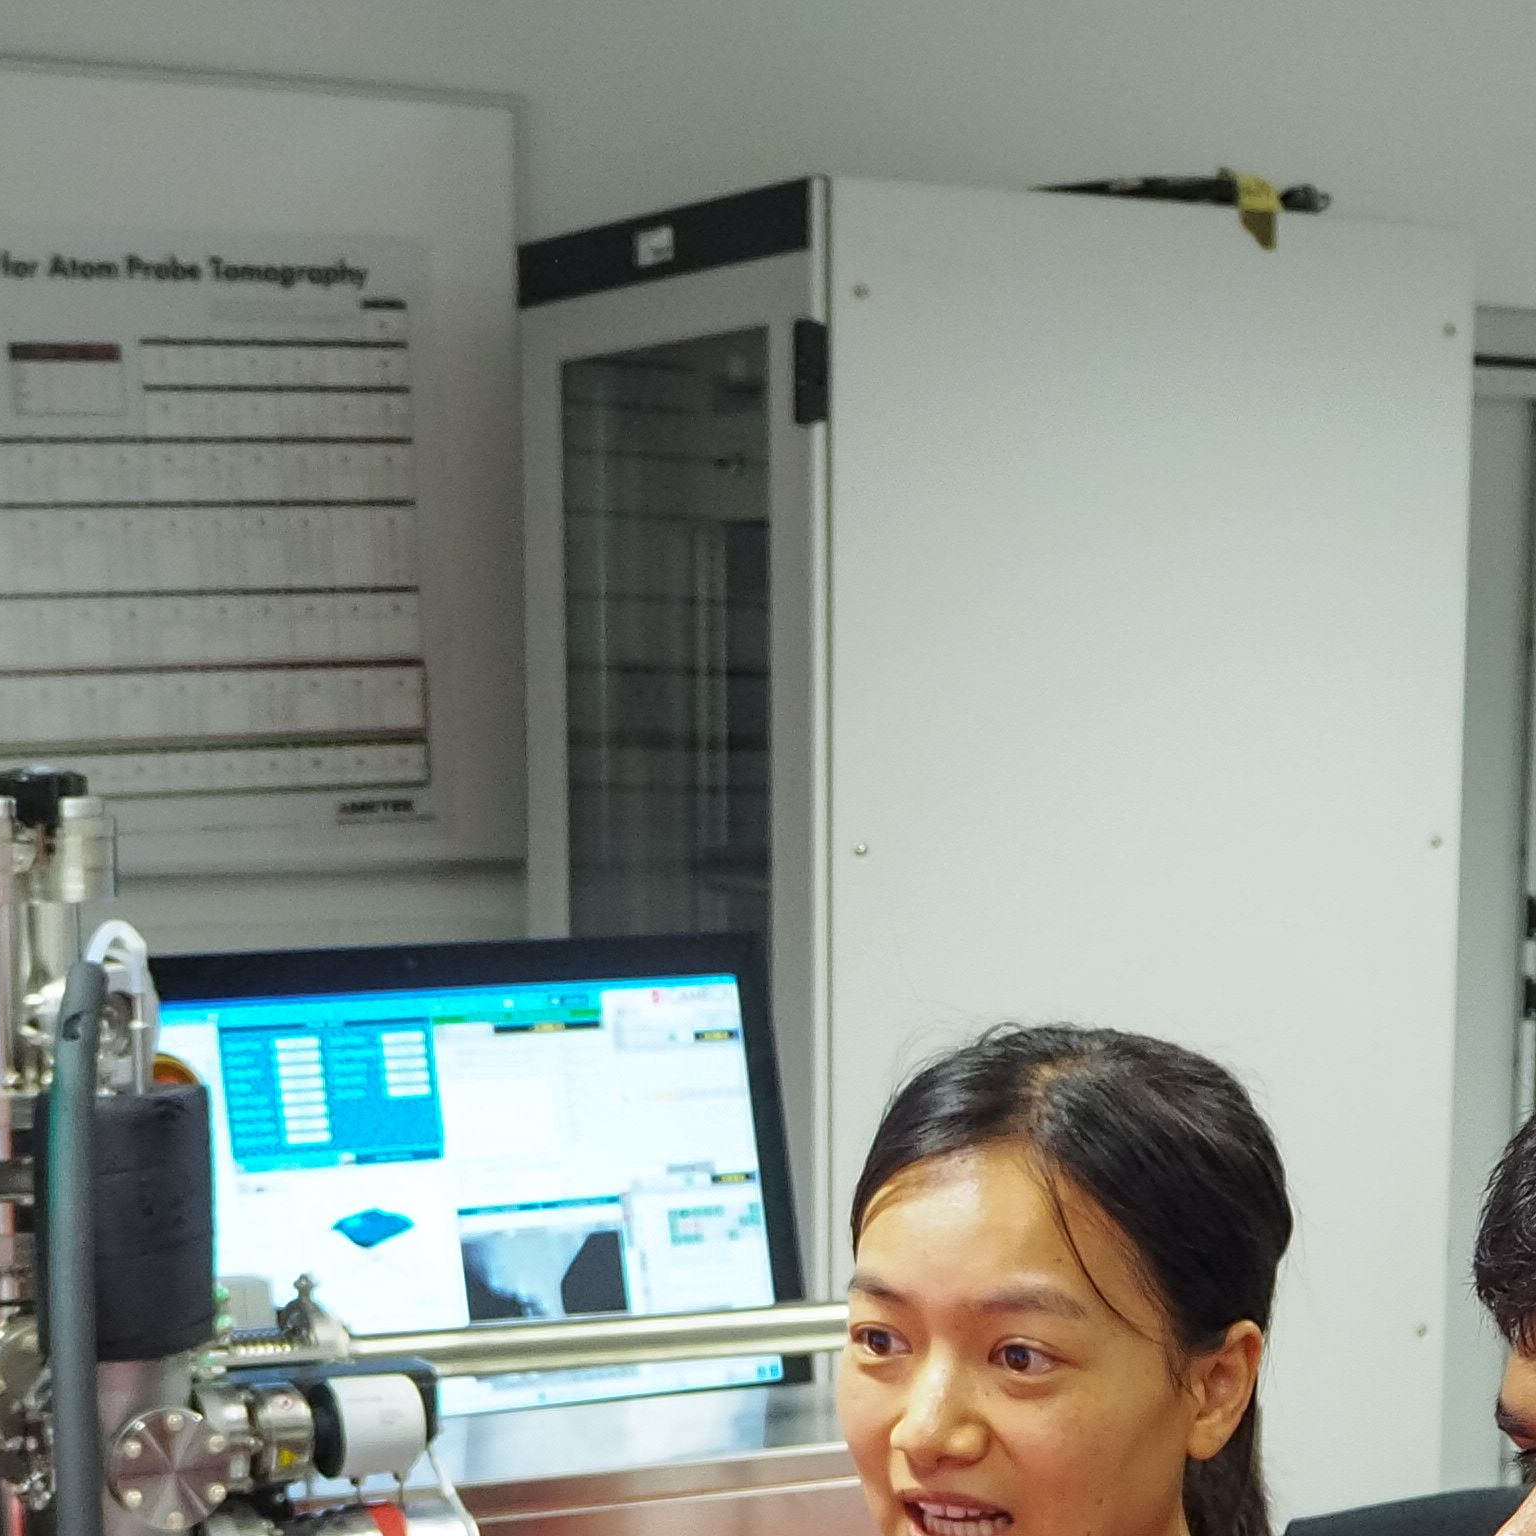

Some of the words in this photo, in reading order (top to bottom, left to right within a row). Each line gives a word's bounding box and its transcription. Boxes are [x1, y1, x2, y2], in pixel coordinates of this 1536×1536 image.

[0, 249, 38, 278] for
[48, 253, 119, 279] Atom
[126, 253, 202, 282] Probe
[209, 255, 369, 290] Tomography
